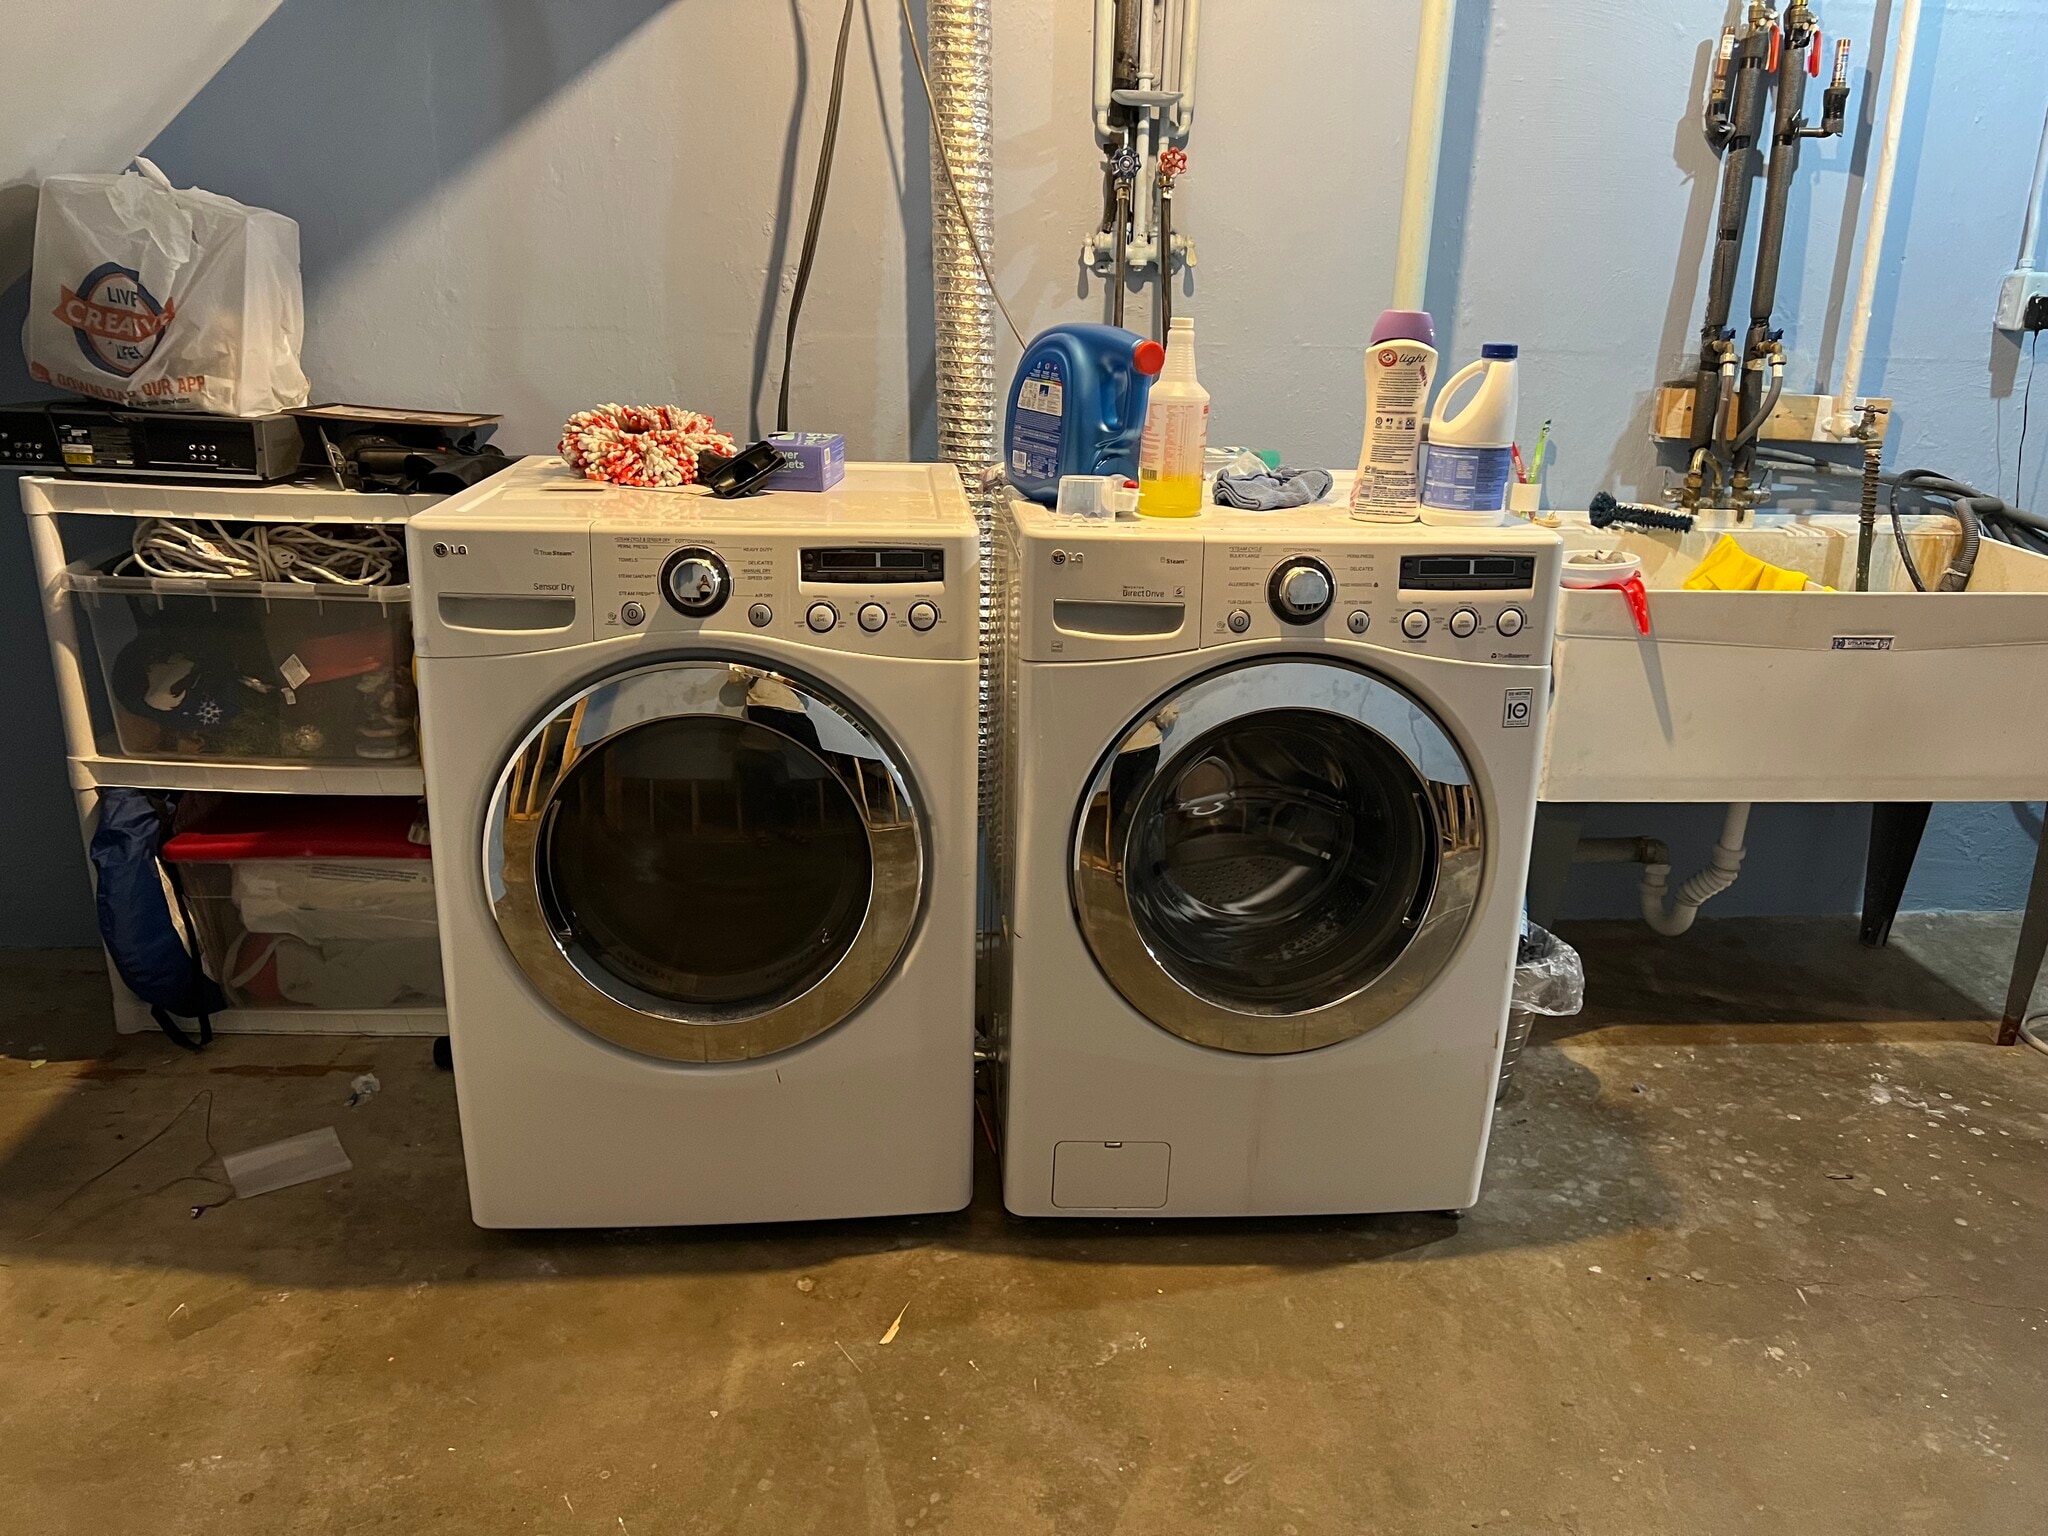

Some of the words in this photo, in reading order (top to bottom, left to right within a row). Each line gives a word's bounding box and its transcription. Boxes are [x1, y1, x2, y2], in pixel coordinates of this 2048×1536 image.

[107, 286, 138, 307] LIVE
[65, 299, 169, 338] CREAIVE
[1399, 353, 1428, 366] light
[141, 377, 173, 396] OUR
[178, 375, 205, 393] APP
[780, 451, 799, 459] yer
[783, 460, 805, 469] ets
[450, 545, 467, 555] LG
[1068, 552, 1084, 564] LG
[533, 583, 559, 591] Sensor
[561, 583, 575, 592] Dry
[1507, 702, 1528, 719] 10
